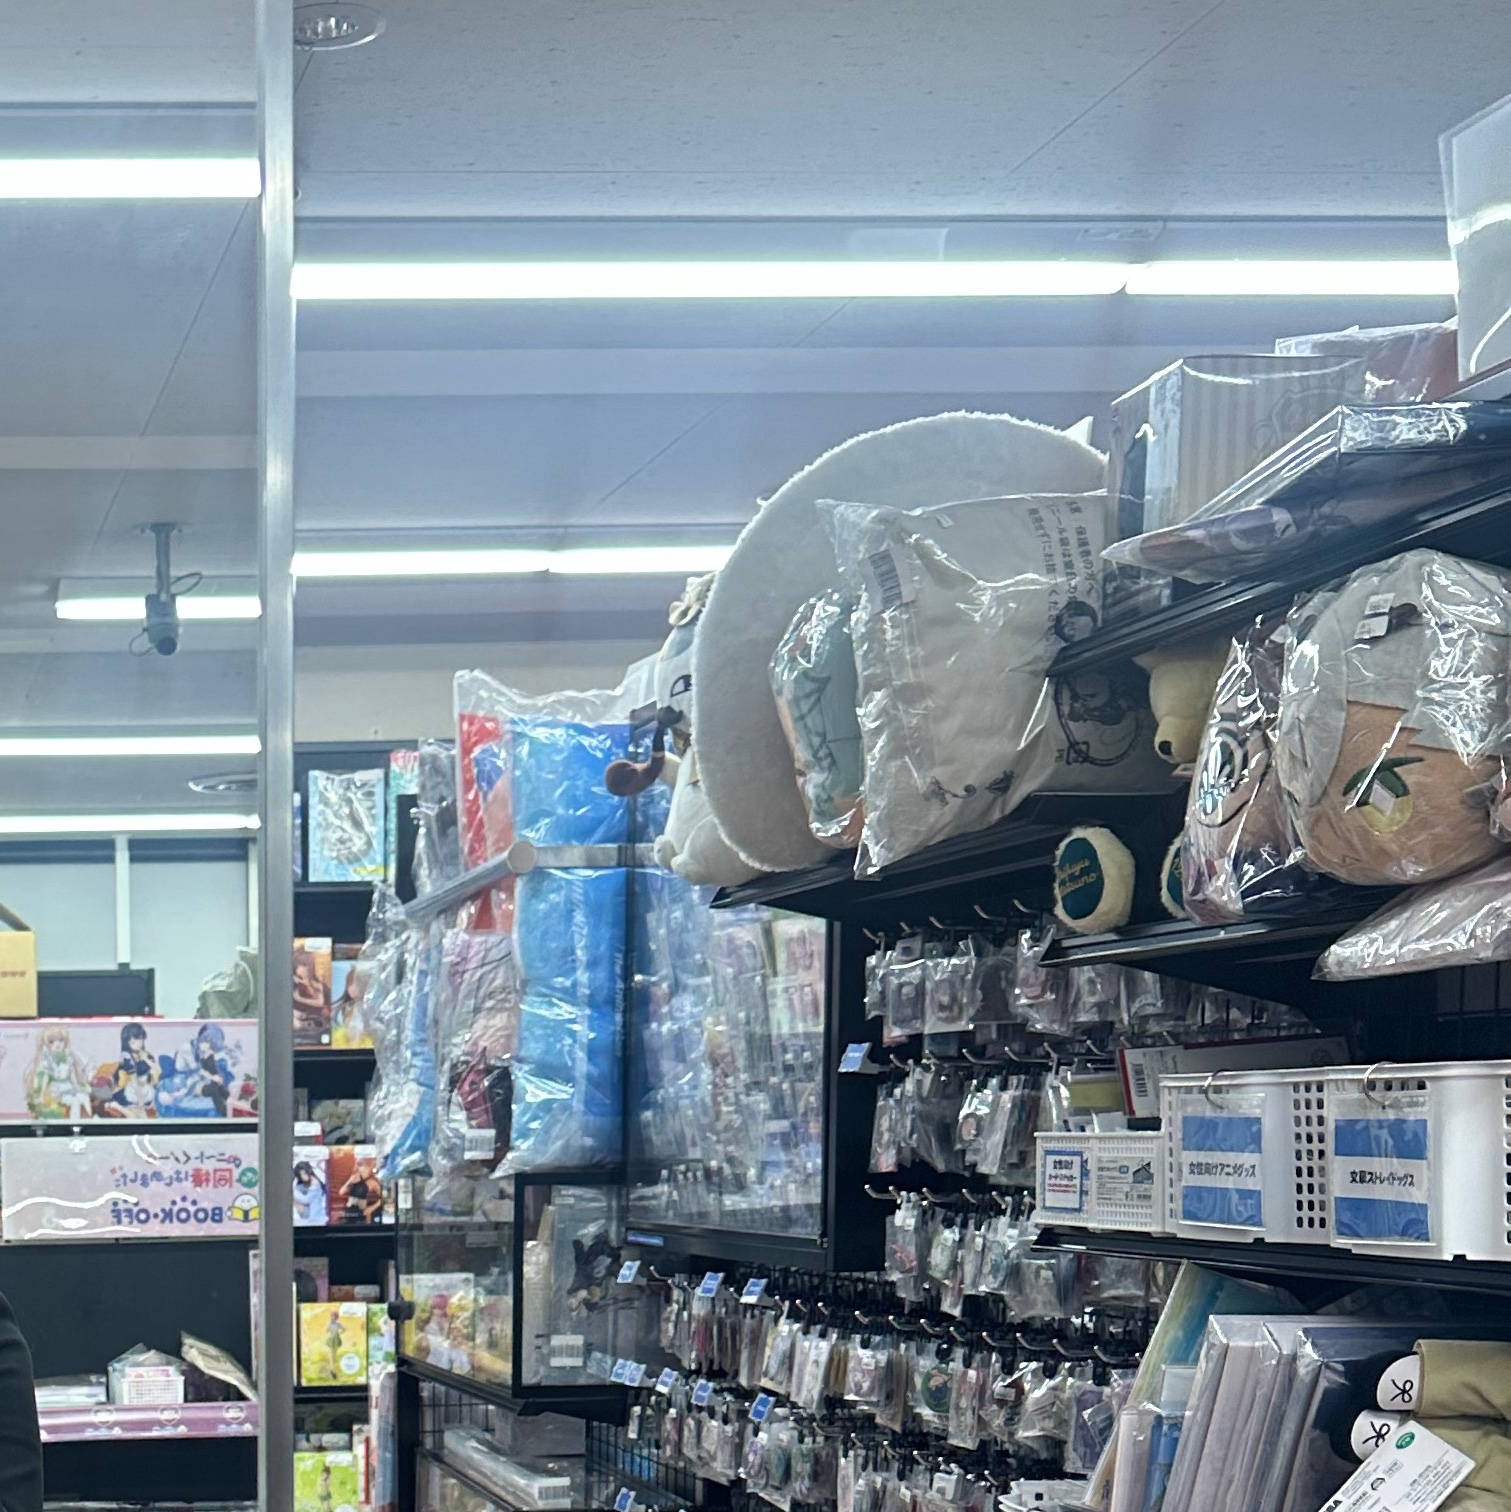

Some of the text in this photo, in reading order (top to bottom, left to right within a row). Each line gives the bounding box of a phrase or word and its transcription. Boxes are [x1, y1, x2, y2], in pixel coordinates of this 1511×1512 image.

[1188, 1160, 1257, 1179] 女性向けアニメグッズ
